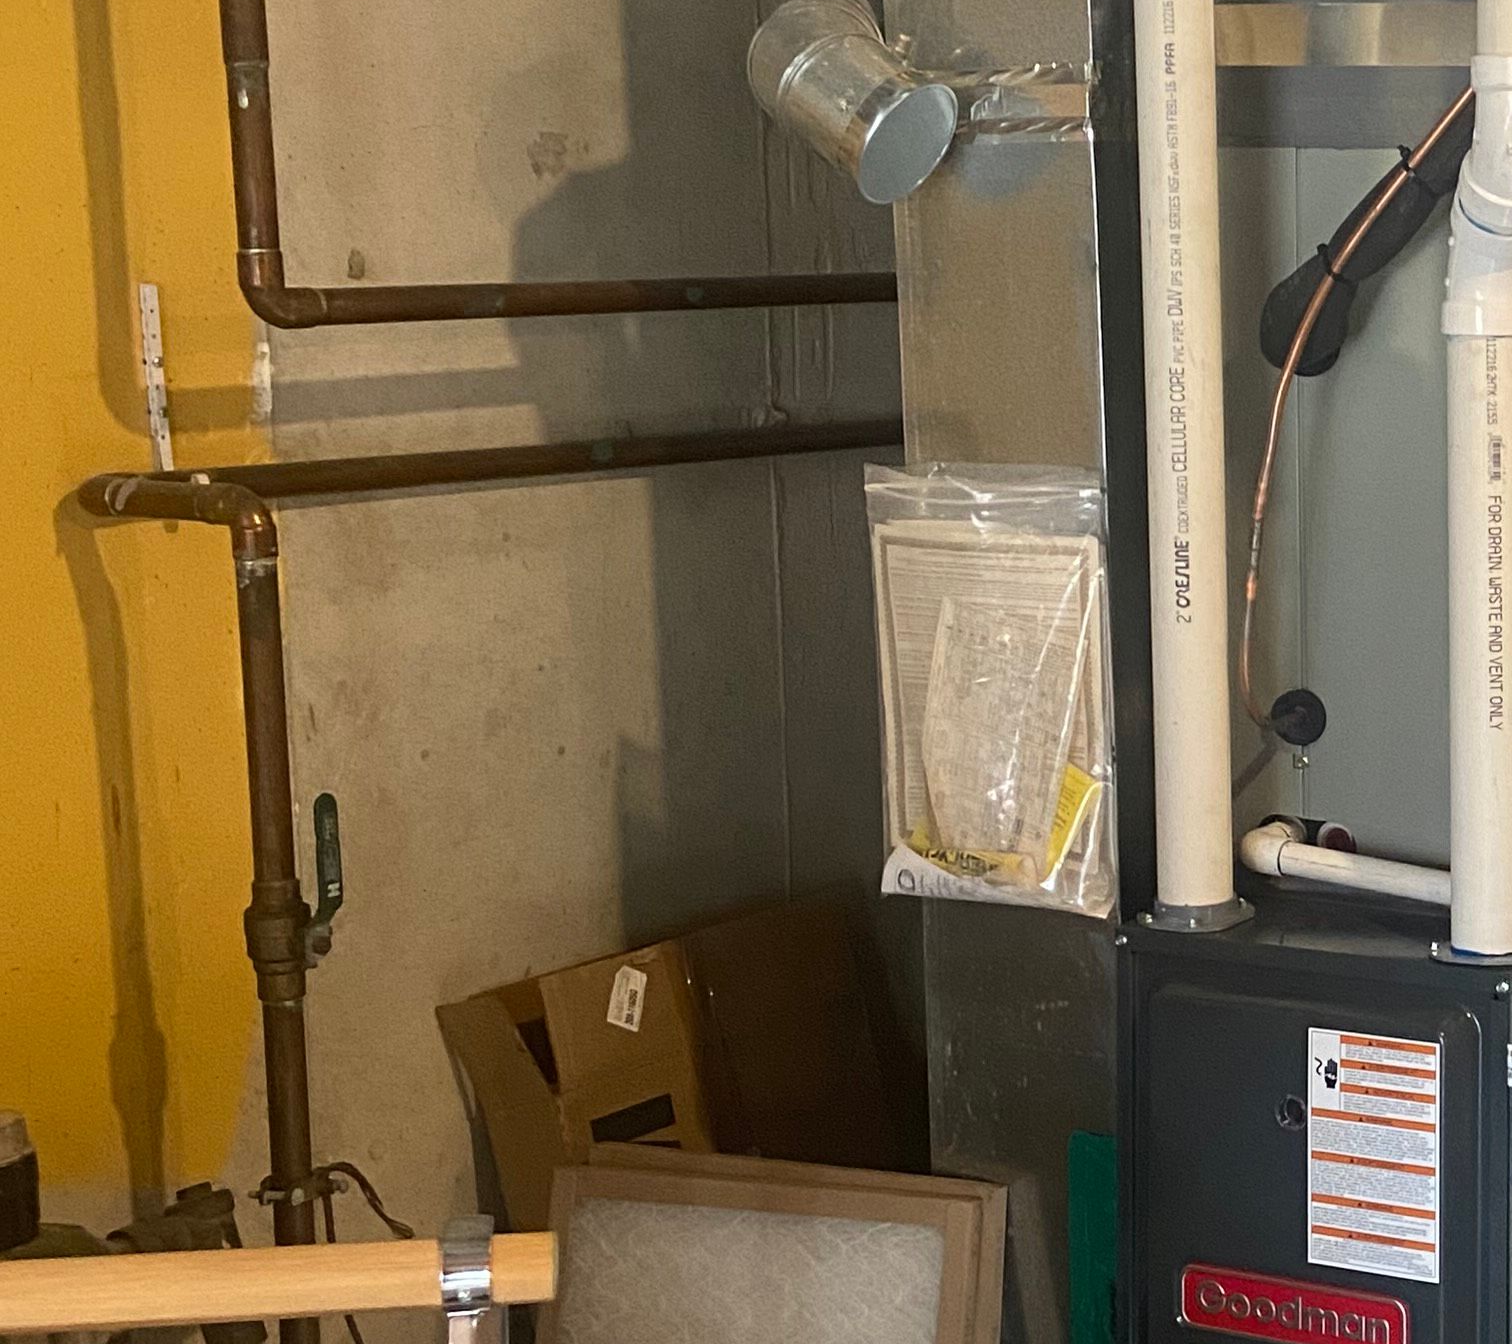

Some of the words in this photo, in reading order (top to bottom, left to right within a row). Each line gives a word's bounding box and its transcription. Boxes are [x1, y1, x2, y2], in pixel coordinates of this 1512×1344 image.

[1164, 43, 1176, 75] PPFA
[1166, 124, 1178, 149] ASTM
[1169, 196, 1181, 230] SERIES
[1170, 248, 1182, 267] SCH
[1167, 289, 1184, 317] DWV
[1172, 320, 1185, 343] PIPE
[1172, 345, 1185, 364] PVC
[1169, 367, 1186, 402] CORE
[1170, 406, 1188, 472] CELLULAR
[1488, 495, 1502, 523] FOR
[1174, 539, 1191, 608] CRESLINE
[1488, 577, 1503, 621] WASTE
[1488, 625, 1503, 653] AND
[1488, 656, 1503, 692] VENT
[1489, 696, 1503, 731] ONLY
